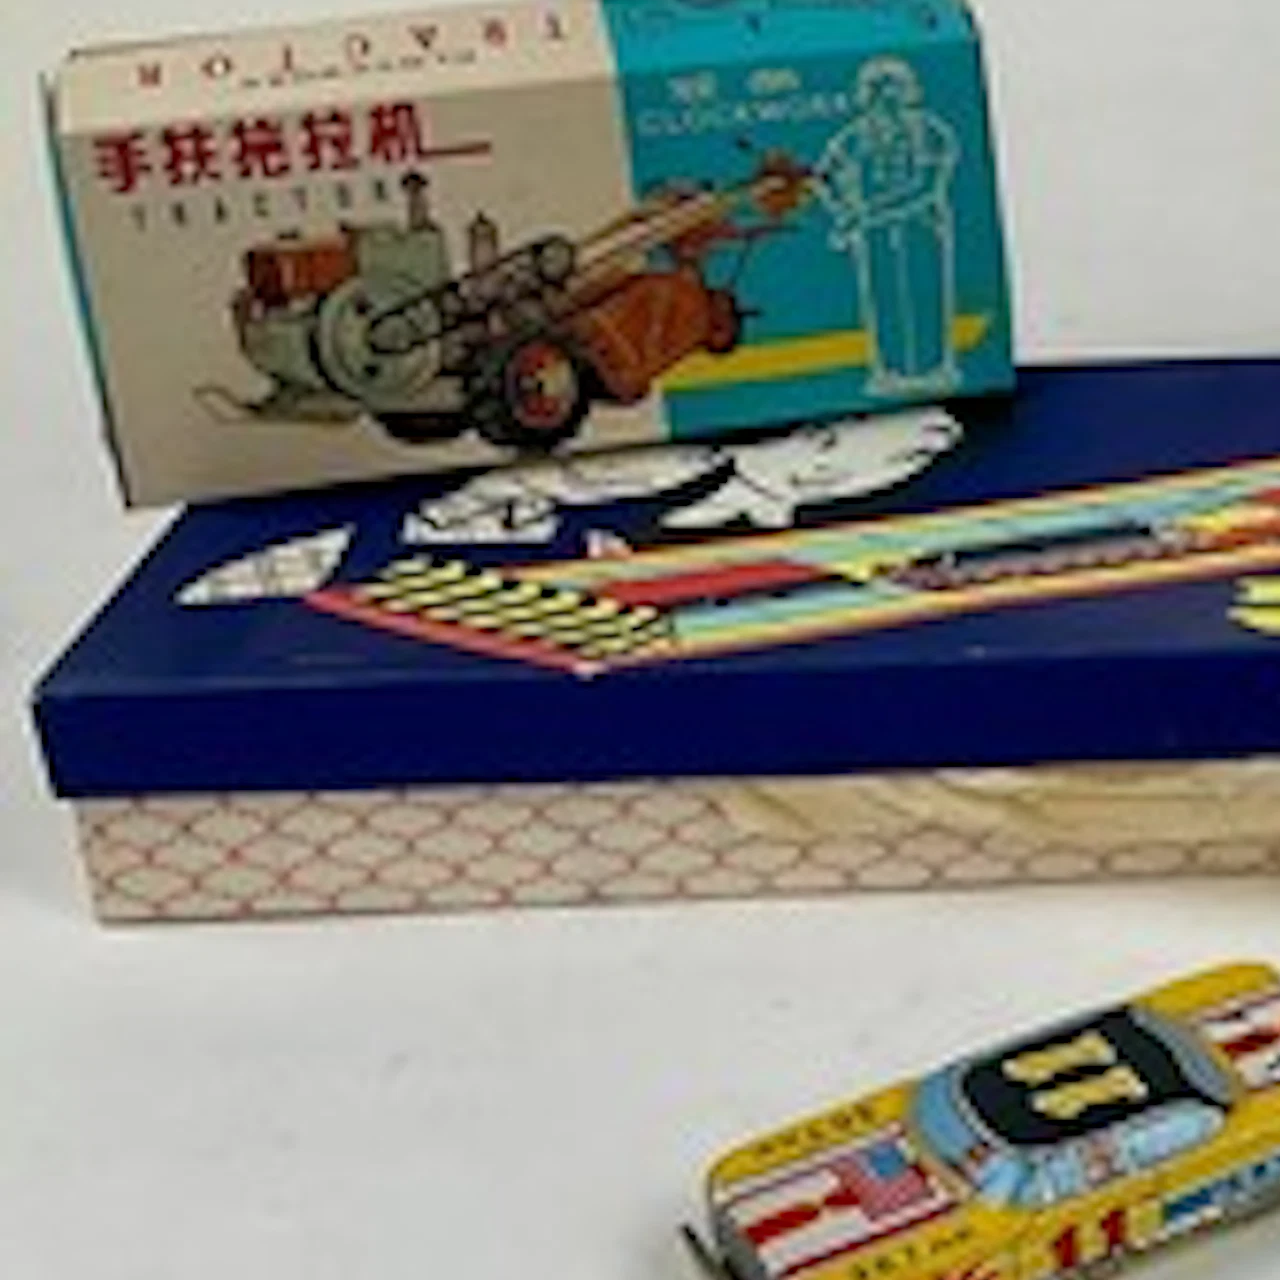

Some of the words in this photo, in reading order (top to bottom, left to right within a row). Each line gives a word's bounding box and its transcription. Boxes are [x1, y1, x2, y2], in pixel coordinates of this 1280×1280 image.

[93, 100, 425, 195] 手扶拖拉机
[128, 178, 392, 232] TRACTOR
